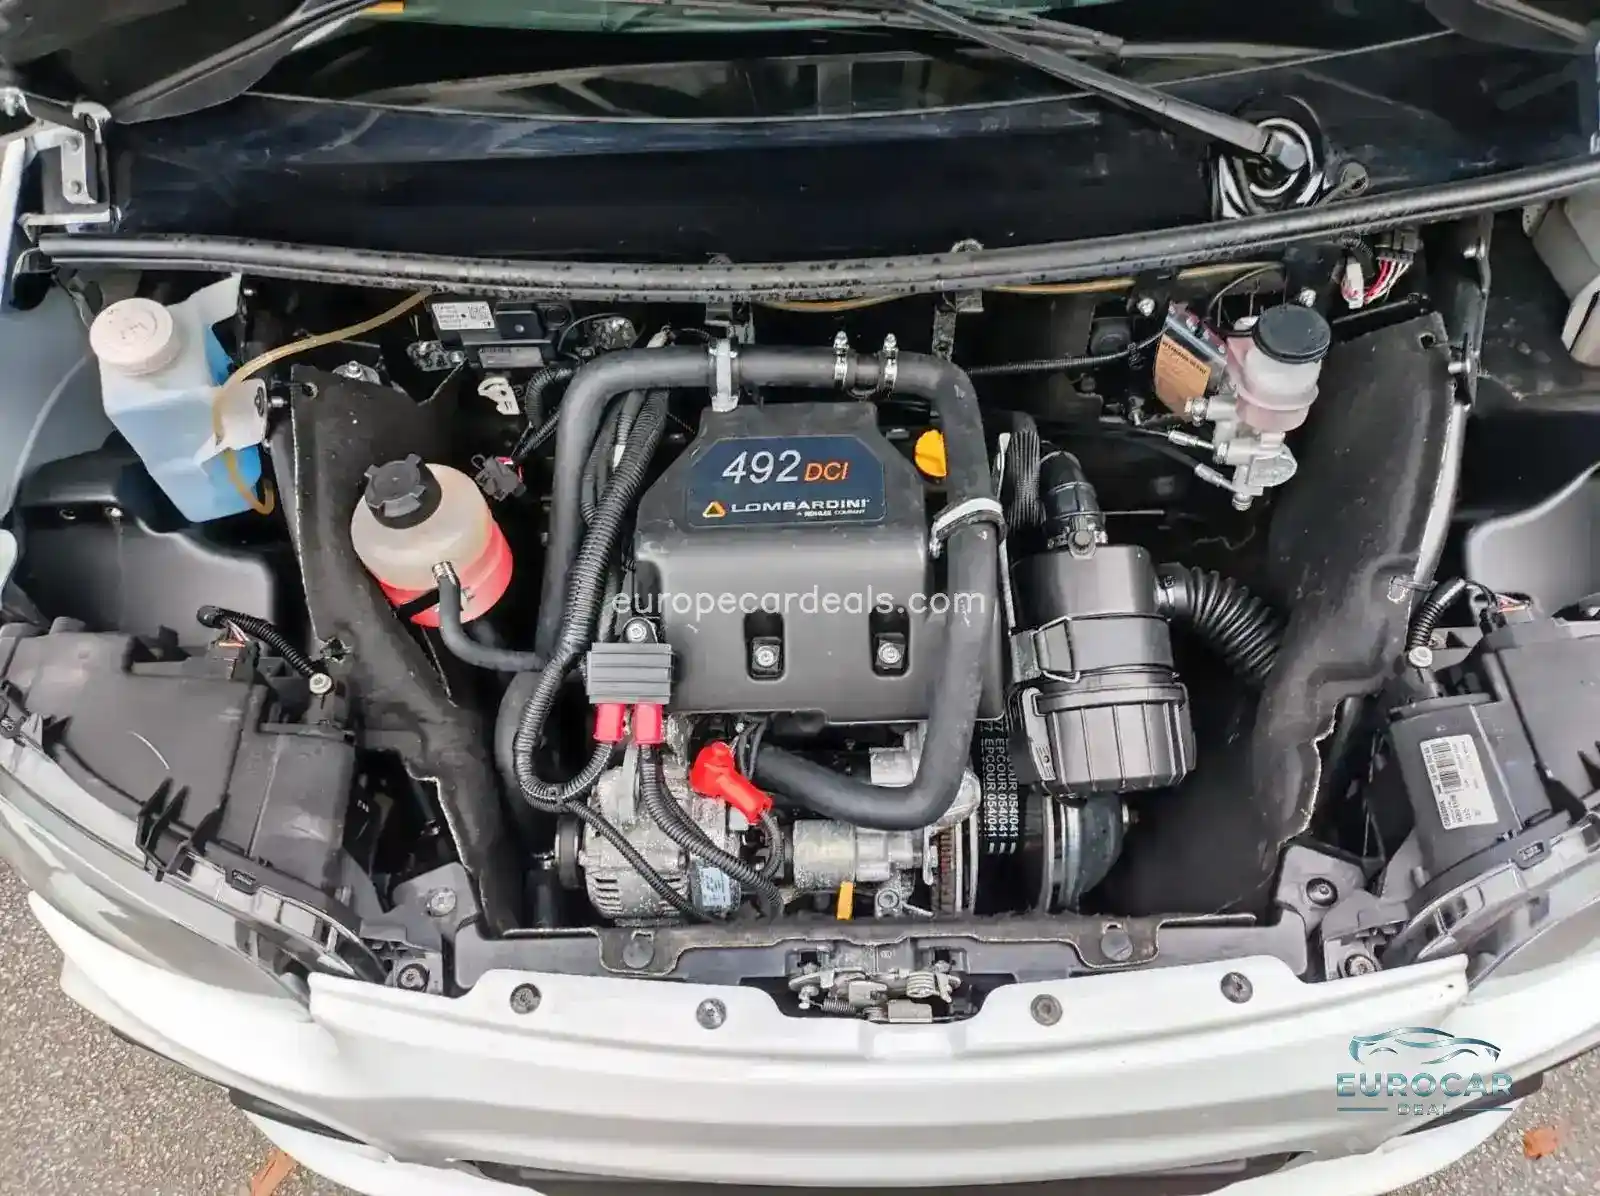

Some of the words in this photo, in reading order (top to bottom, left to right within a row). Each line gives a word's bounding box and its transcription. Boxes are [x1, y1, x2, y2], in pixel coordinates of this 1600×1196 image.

[722, 450, 802, 484] 492
[804, 462, 849, 482] DCI
[731, 498, 867, 513] LOMBARDINI
